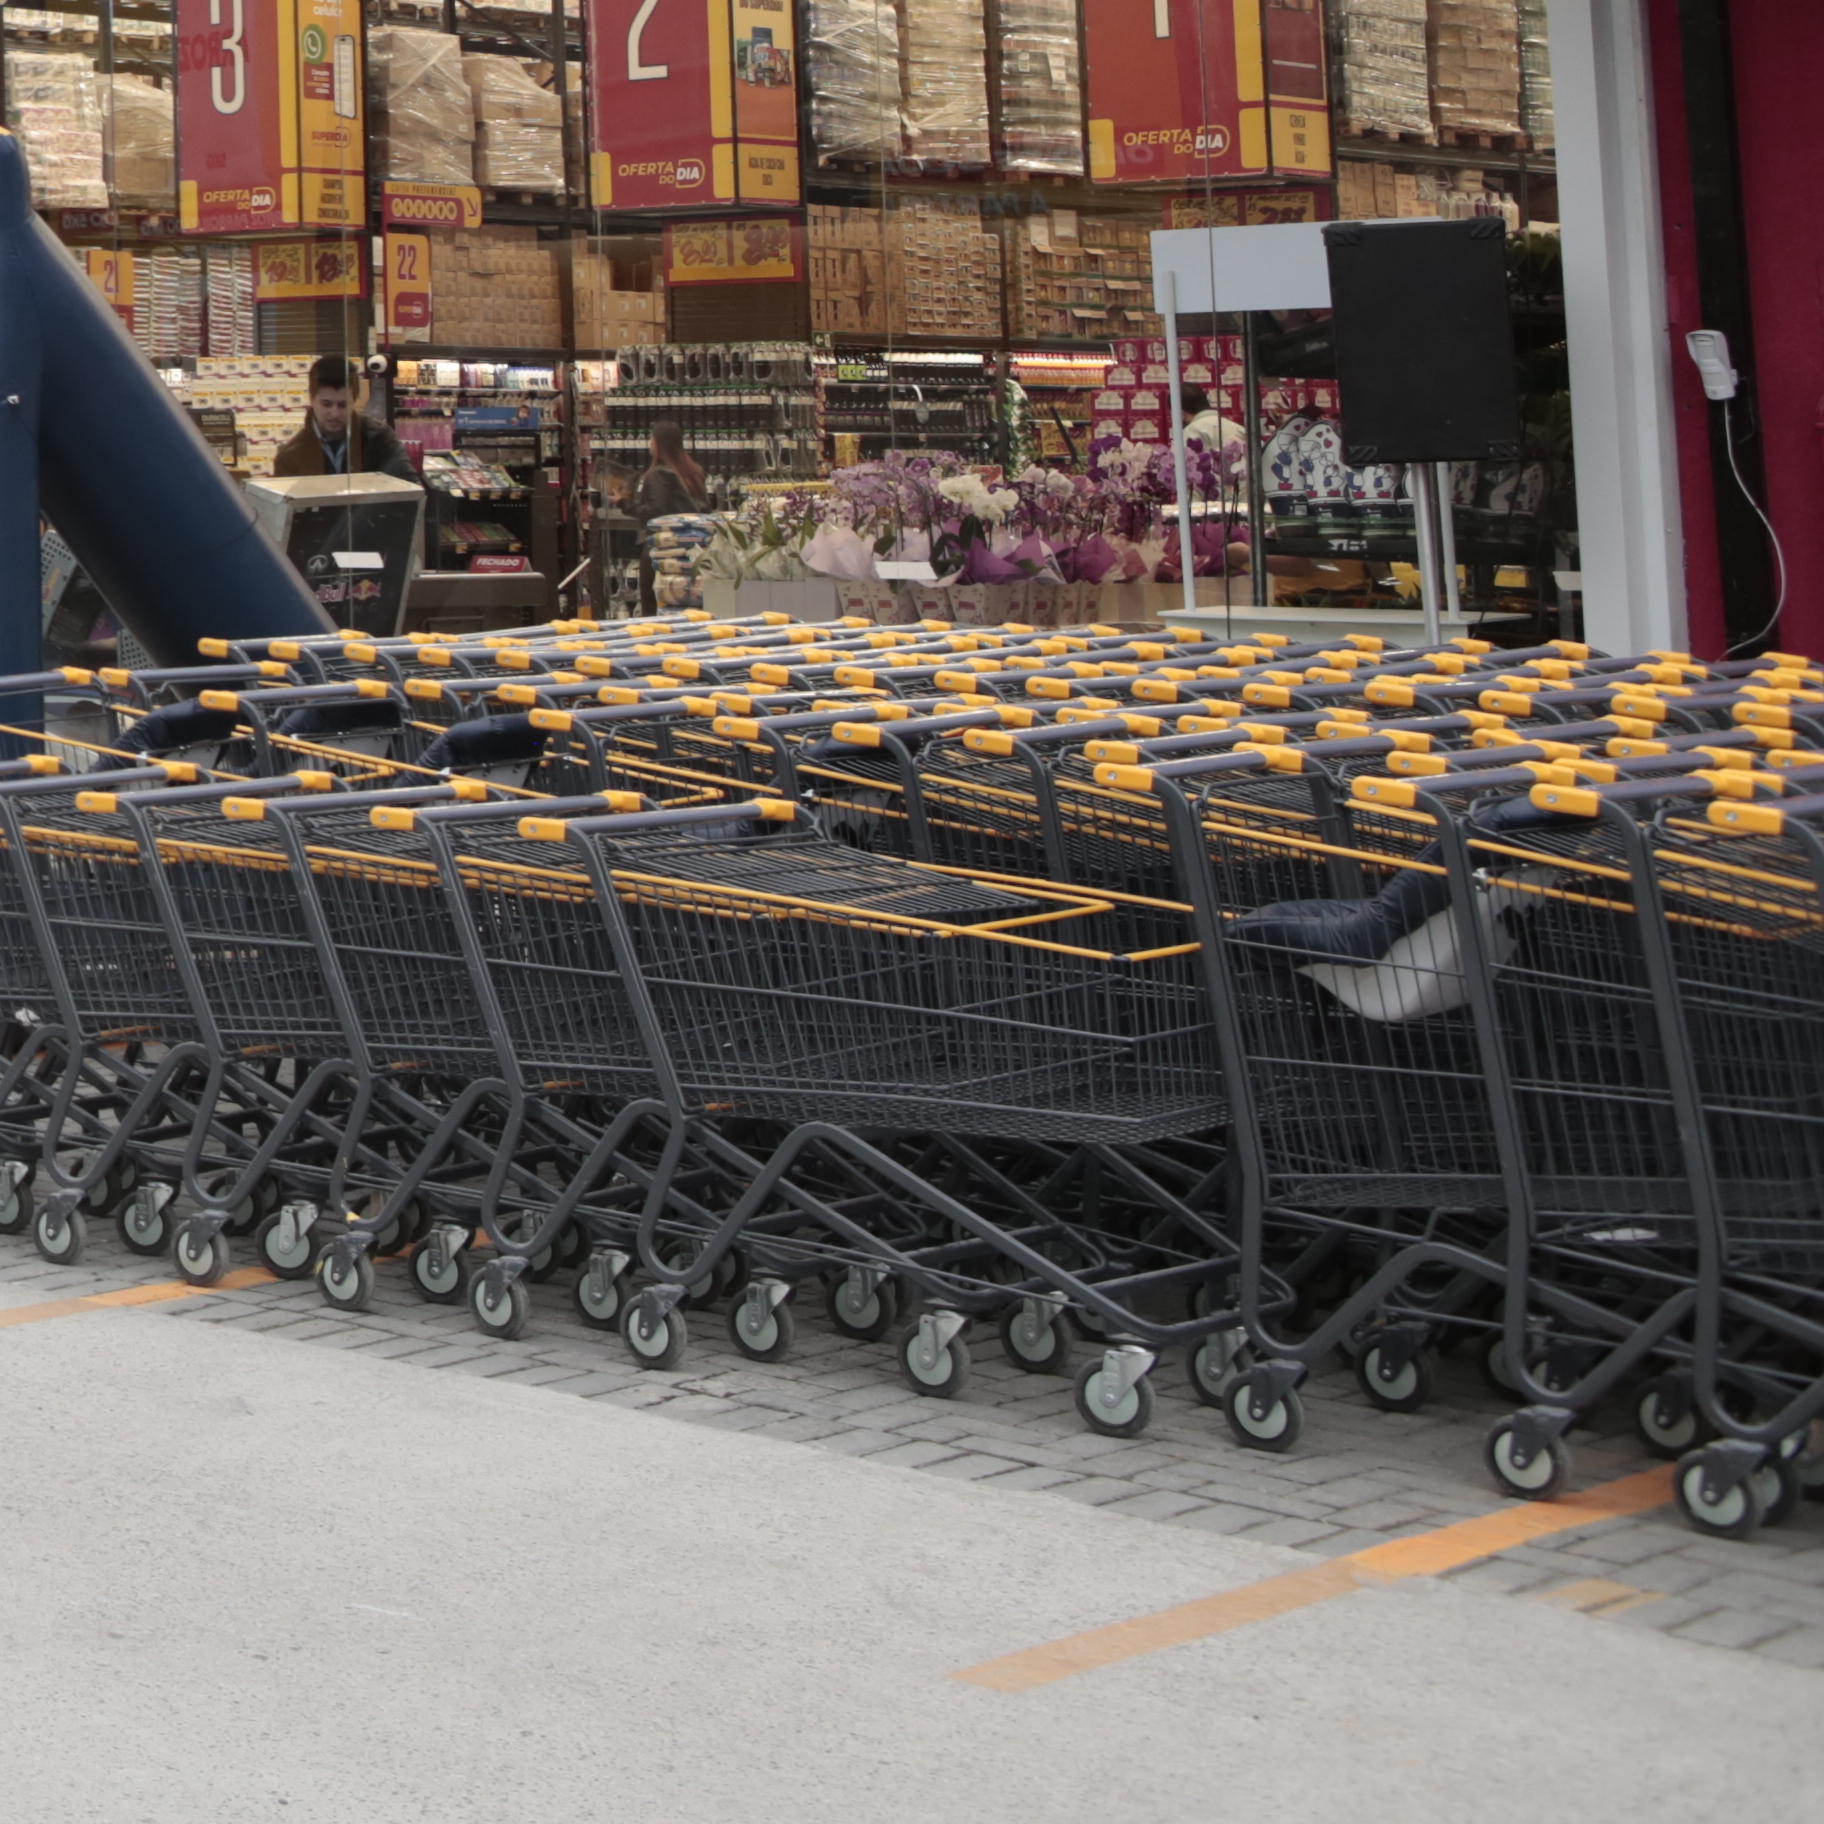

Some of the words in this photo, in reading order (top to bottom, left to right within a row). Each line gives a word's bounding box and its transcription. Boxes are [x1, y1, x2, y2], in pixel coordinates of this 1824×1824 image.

[1123, 128, 1193, 147] OFERTA
[1173, 142, 1194, 154] DO
[1195, 133, 1224, 149] DIA
[618, 161, 675, 177] OFERTA
[658, 175, 675, 185] DO
[675, 166, 701, 181] DIA
[203, 188, 251, 203] OFERTA
[251, 193, 272, 207] DIA
[396, 243, 418, 281] 22
[476, 556, 520, 567] FECHADO
